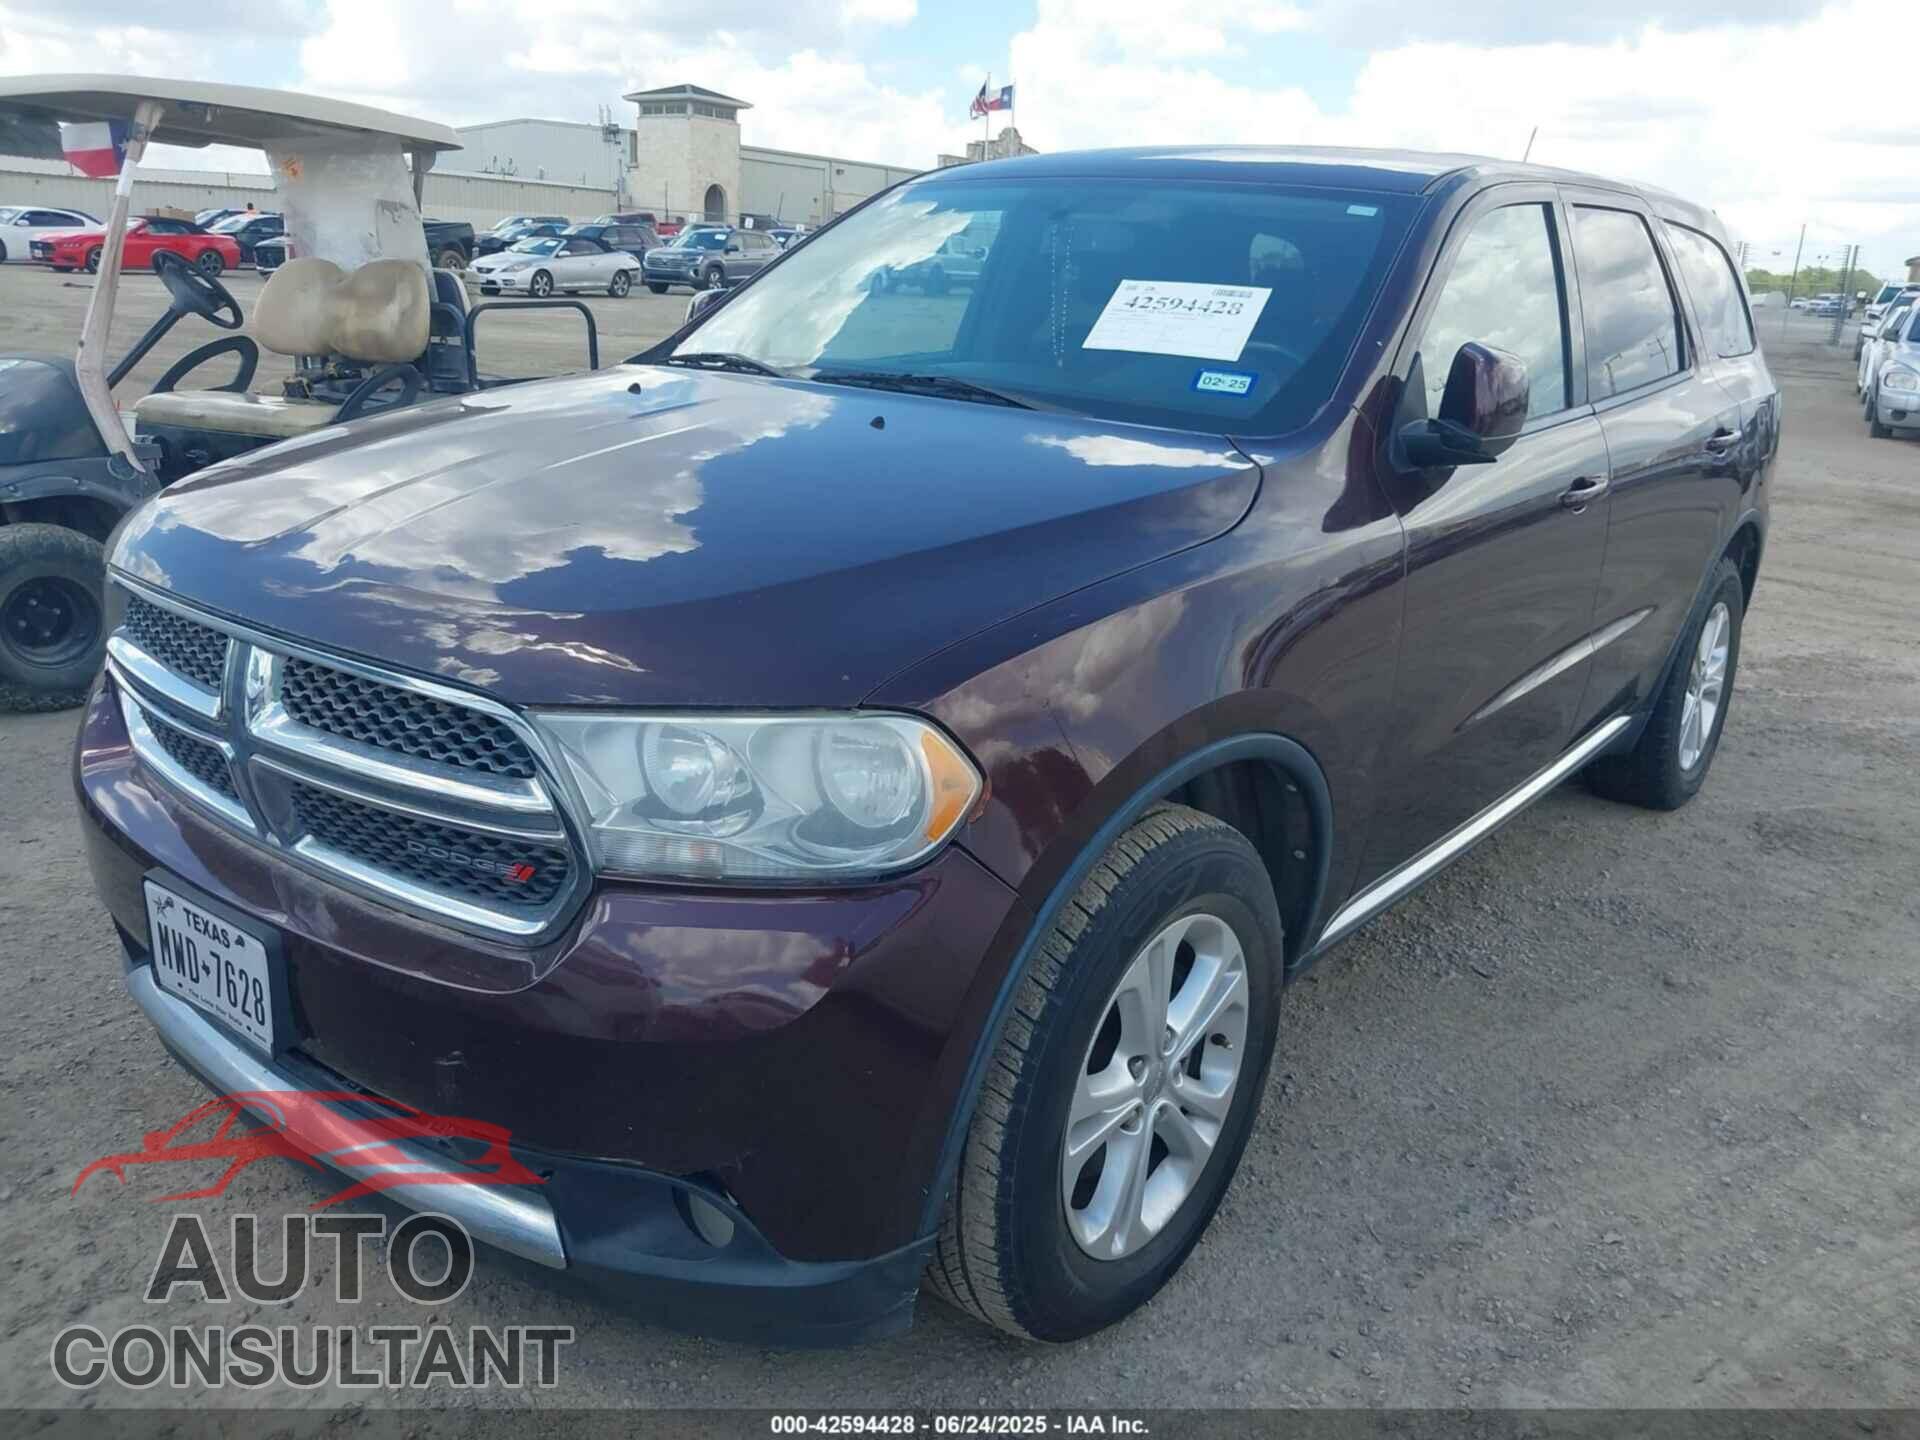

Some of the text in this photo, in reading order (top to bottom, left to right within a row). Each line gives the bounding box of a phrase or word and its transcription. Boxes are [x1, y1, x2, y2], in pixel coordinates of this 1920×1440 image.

[1123, 296, 1243, 315] 42594428
[407, 840, 518, 877] DODGE
[183, 907, 230, 948] TEXAS
